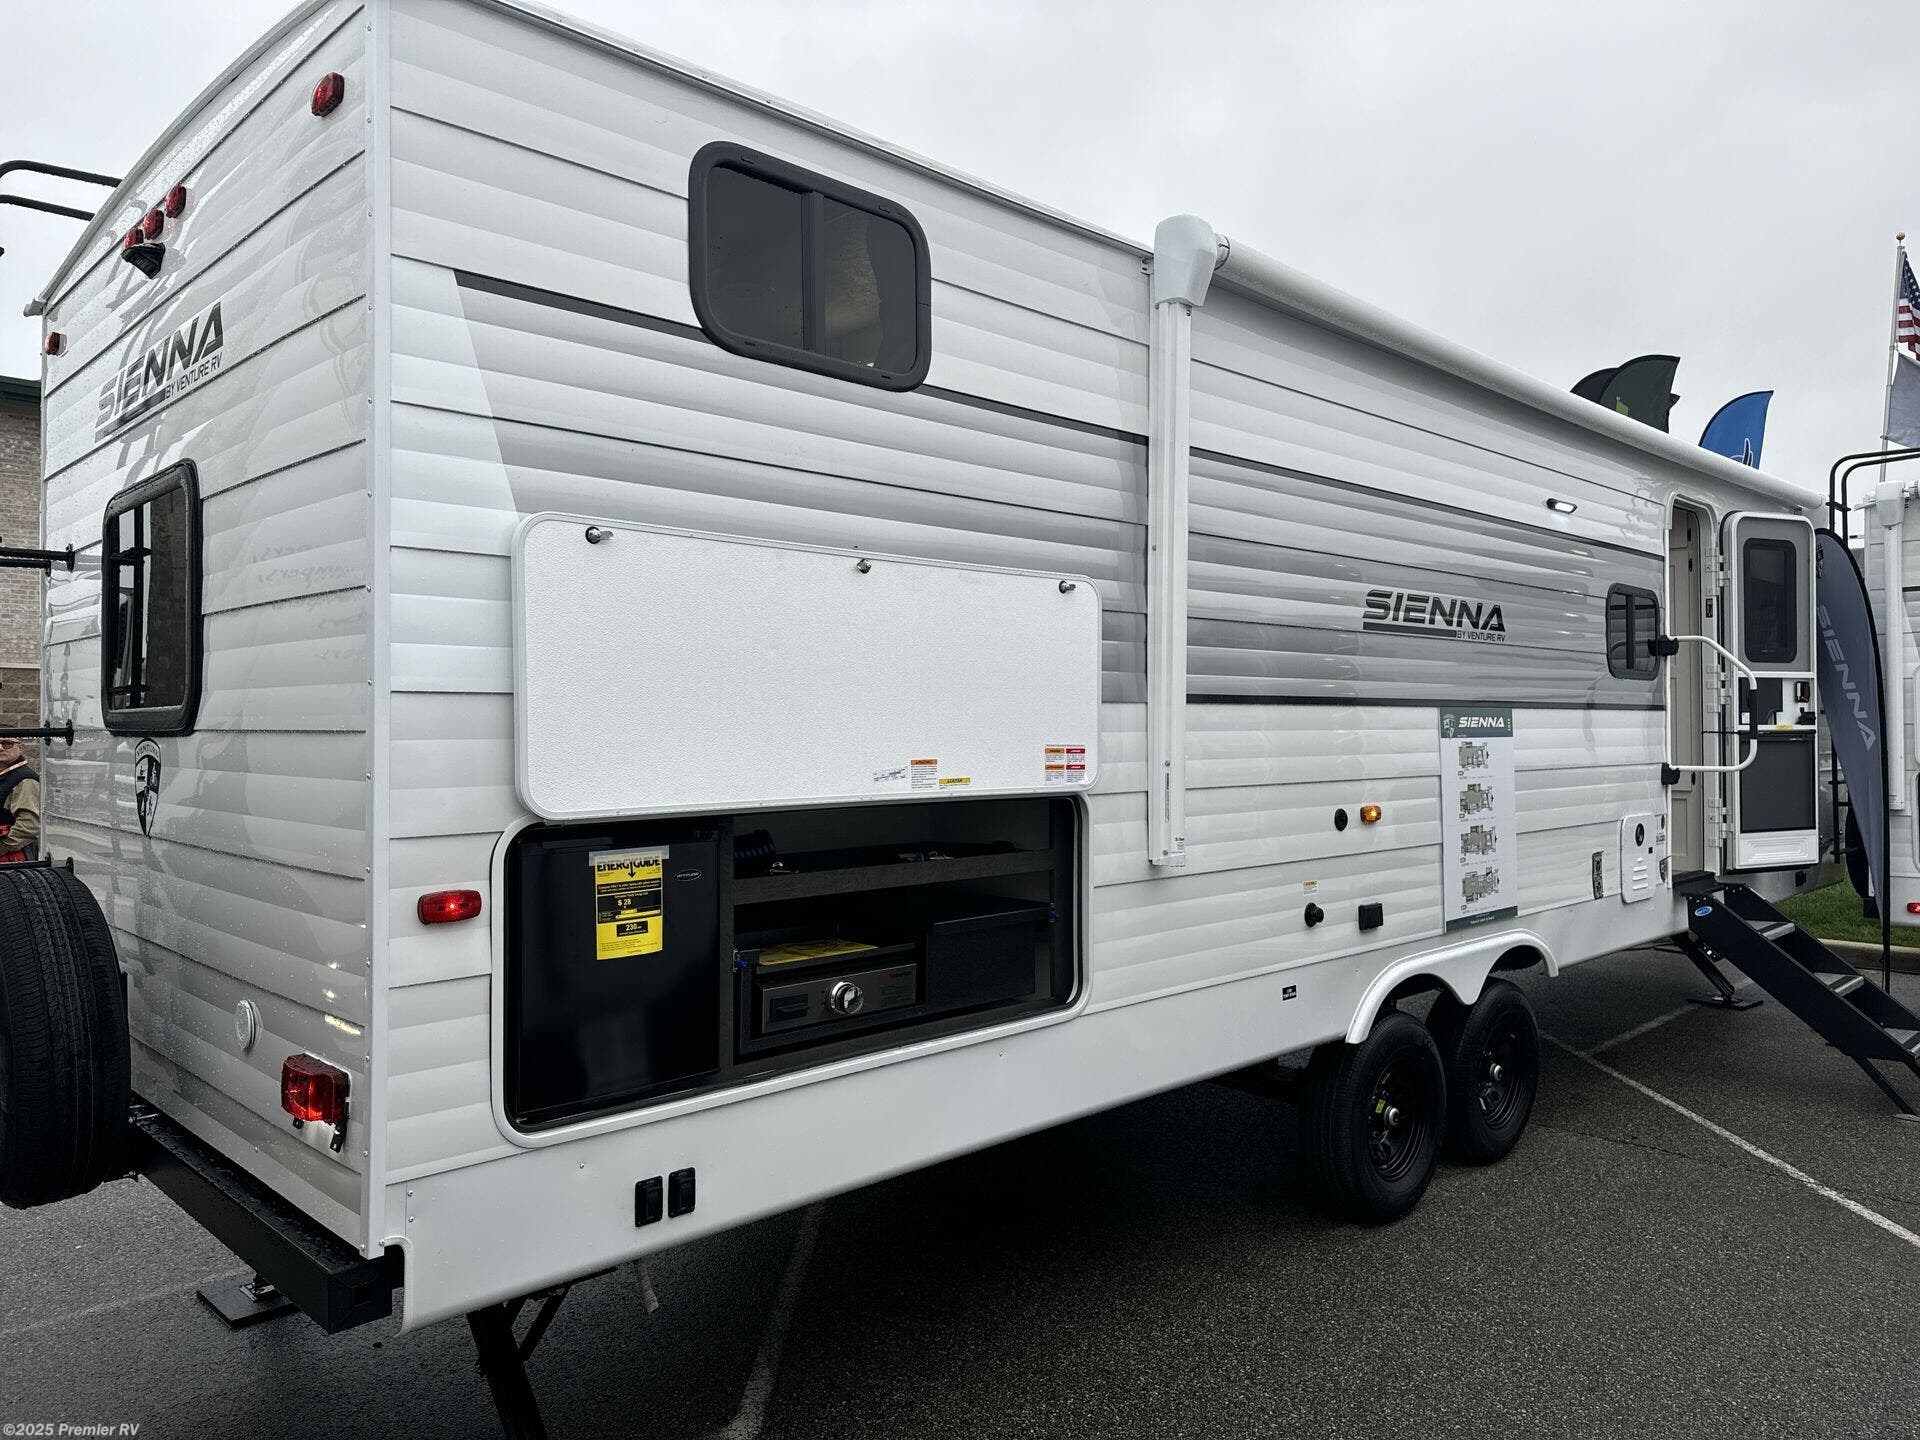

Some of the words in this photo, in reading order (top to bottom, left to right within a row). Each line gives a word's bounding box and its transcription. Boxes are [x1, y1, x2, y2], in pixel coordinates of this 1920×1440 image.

[95, 302, 223, 428] SIENNA
[165, 381, 176, 399] BY
[176, 360, 210, 392] VENTURE
[210, 352, 223, 372] RV
[1363, 589, 1506, 632] SIENNA
[1457, 630, 1467, 639] BY
[1467, 631, 1496, 642] VENTURE
[1496, 633, 1506, 643] RV
[1817, 604, 1876, 751] SIENNA
[1458, 716, 1505, 728] SIENNA
